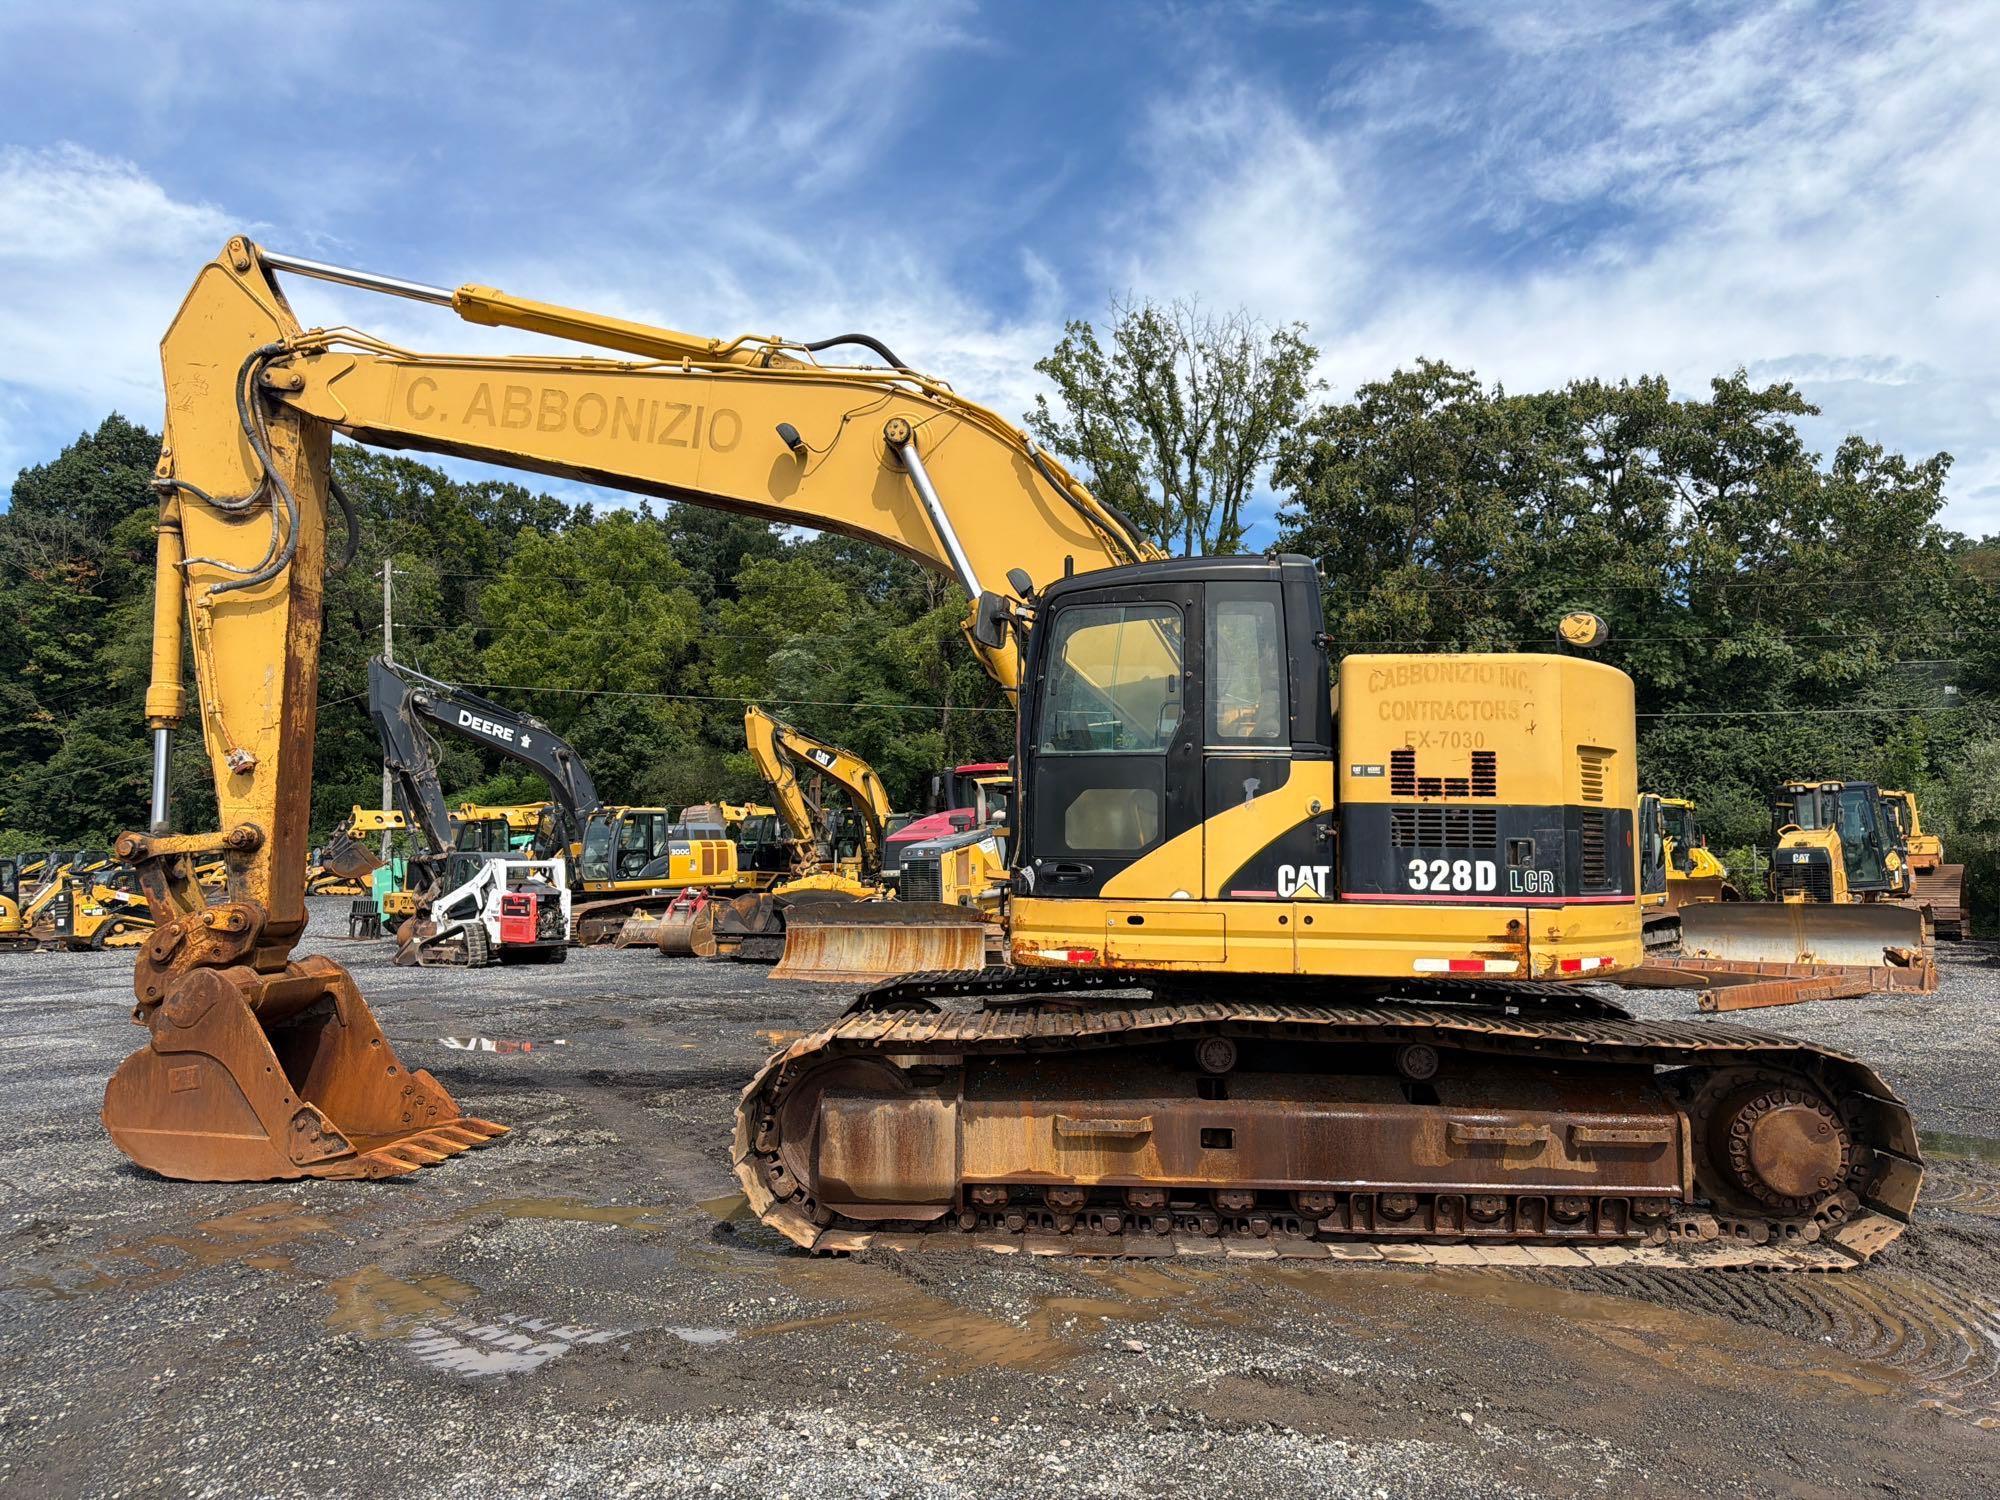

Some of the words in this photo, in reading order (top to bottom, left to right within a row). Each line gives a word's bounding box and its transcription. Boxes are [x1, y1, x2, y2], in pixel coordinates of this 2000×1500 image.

[405, 376, 448, 421] C.
[462, 382, 743, 453] ABBONIZIO
[458, 709, 514, 742] DEERE
[1378, 700, 1520, 721] CONTRACTORS
[815, 749, 830, 765] CAT
[1792, 853, 1810, 864] CAT
[1277, 864, 1330, 898] CAT
[1408, 859, 1496, 891] 328D
[1509, 870, 1554, 892] LCR
